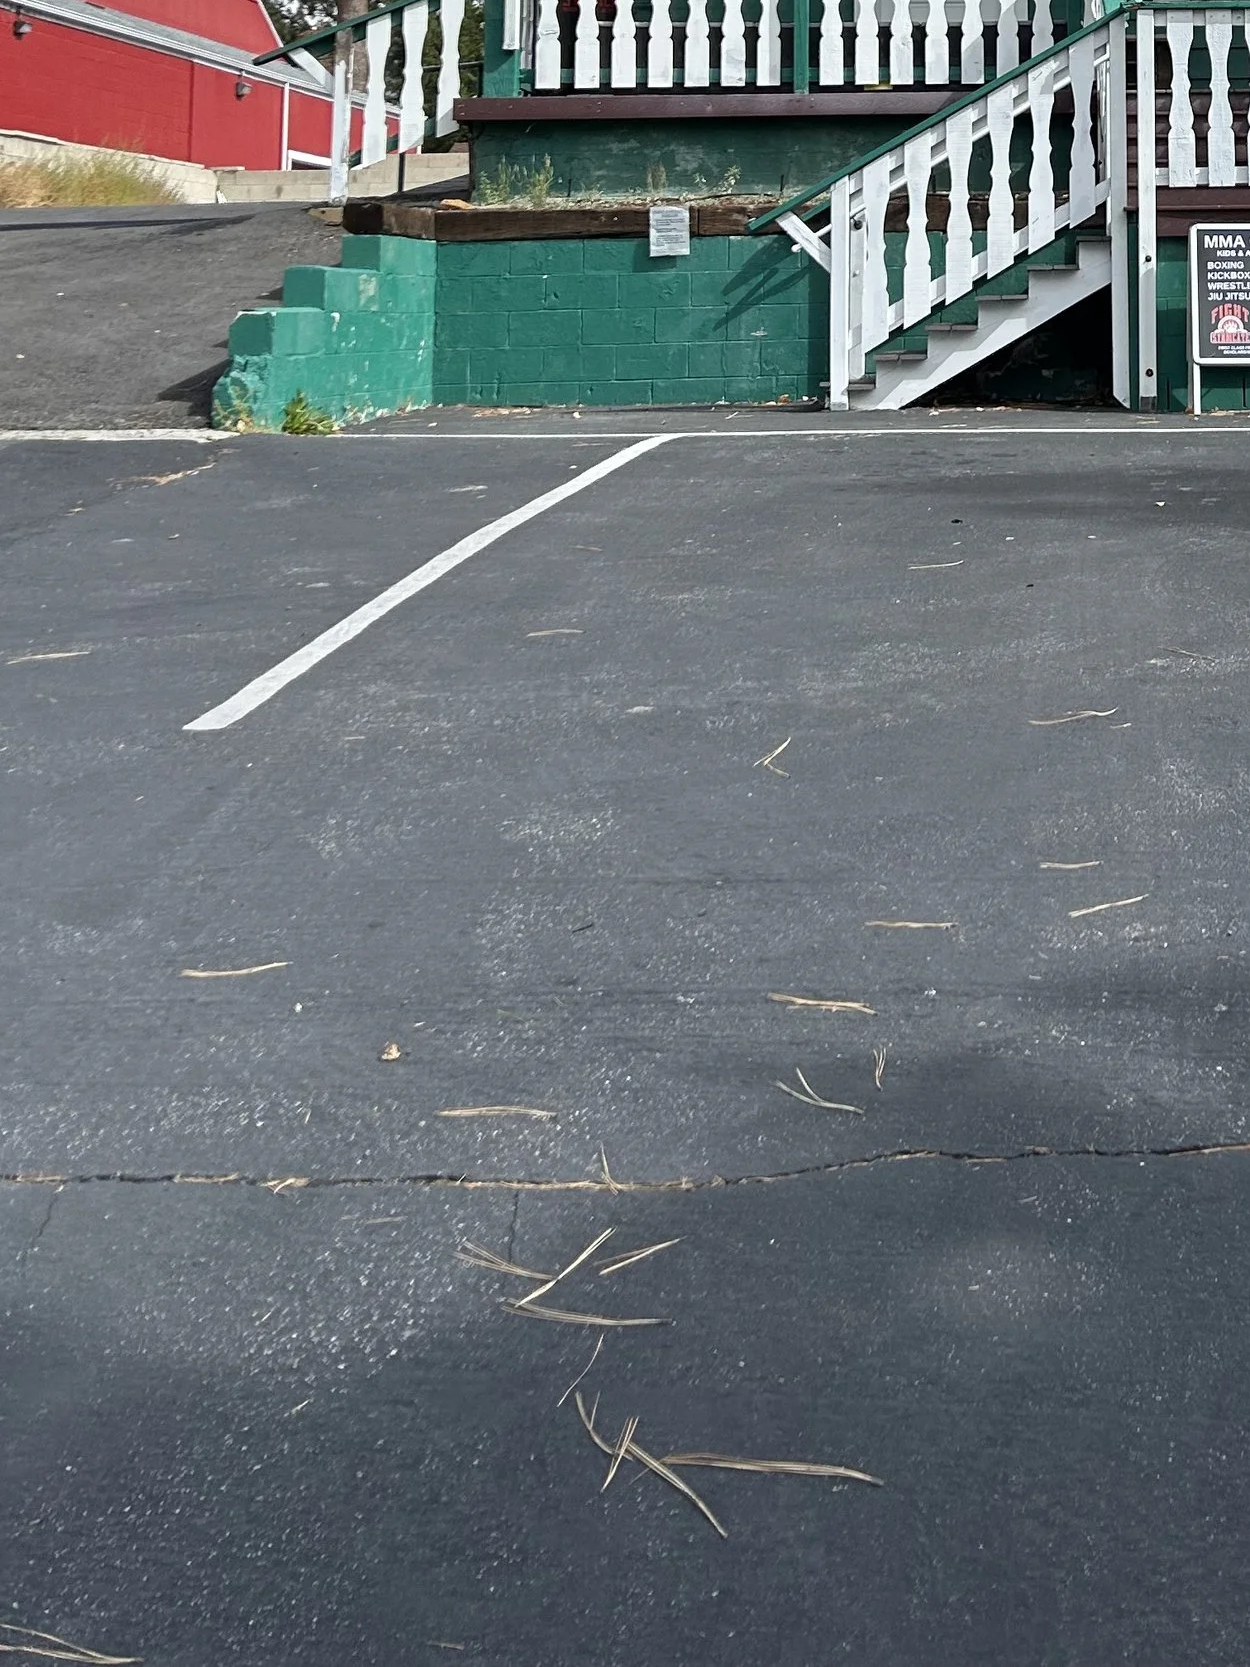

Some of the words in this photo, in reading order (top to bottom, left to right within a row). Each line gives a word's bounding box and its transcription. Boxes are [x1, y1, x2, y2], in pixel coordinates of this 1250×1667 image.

[1204, 235, 1246, 249] MMA
[1207, 261, 1245, 270] BOXING
[1207, 292, 1223, 301] JIU
[1211, 303, 1250, 325] FIGHT
[1211, 331, 1250, 343] SYNDICATE
